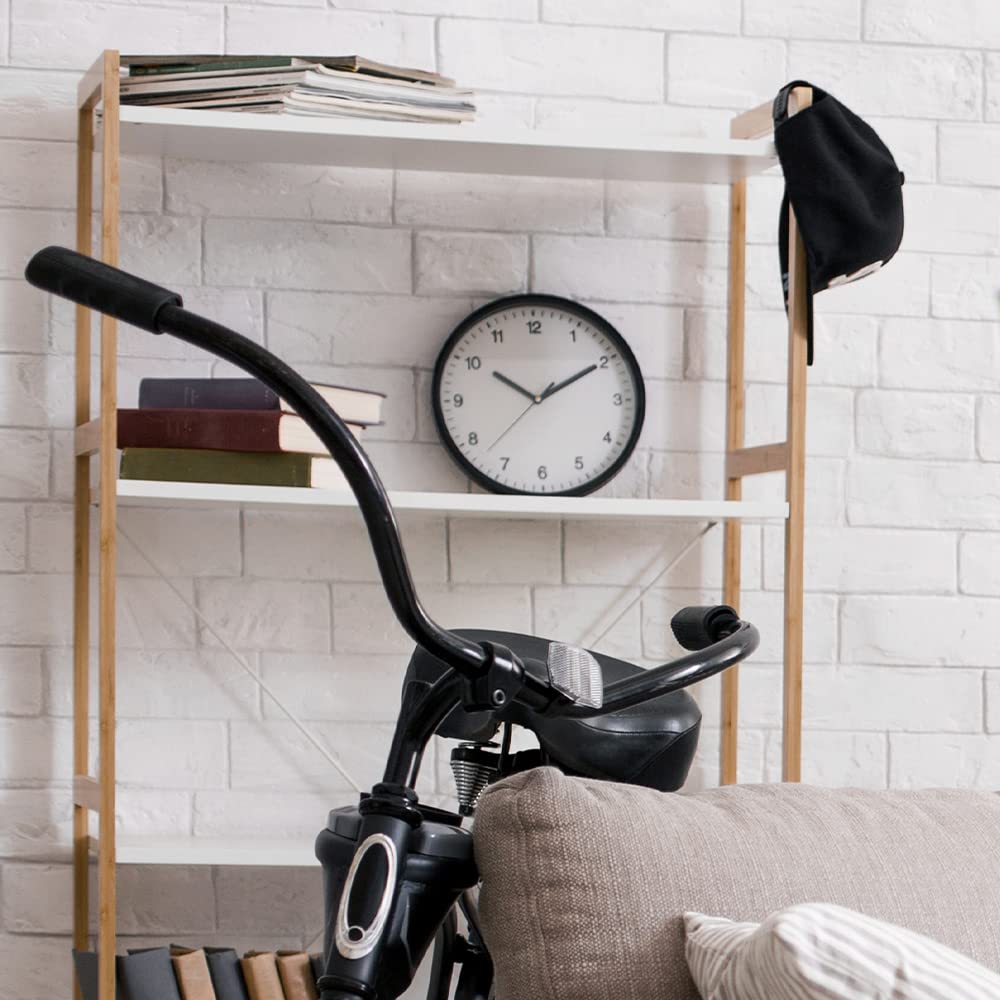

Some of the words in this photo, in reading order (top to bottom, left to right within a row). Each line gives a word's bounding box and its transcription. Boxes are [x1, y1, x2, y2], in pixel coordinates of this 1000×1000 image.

[526, 320, 542, 335] 12
[491, 329, 503, 343] 11
[569, 331, 577, 342] 1
[465, 356, 482, 370] 10
[599, 357, 609, 369] 2
[453, 394, 463, 408] 9
[613, 394, 623, 406] 3
[468, 432, 478, 446] 8
[603, 432, 612, 443] 4
[500, 457, 510, 471] 7
[574, 456, 584, 470] 5
[537, 466, 548, 480] 6
